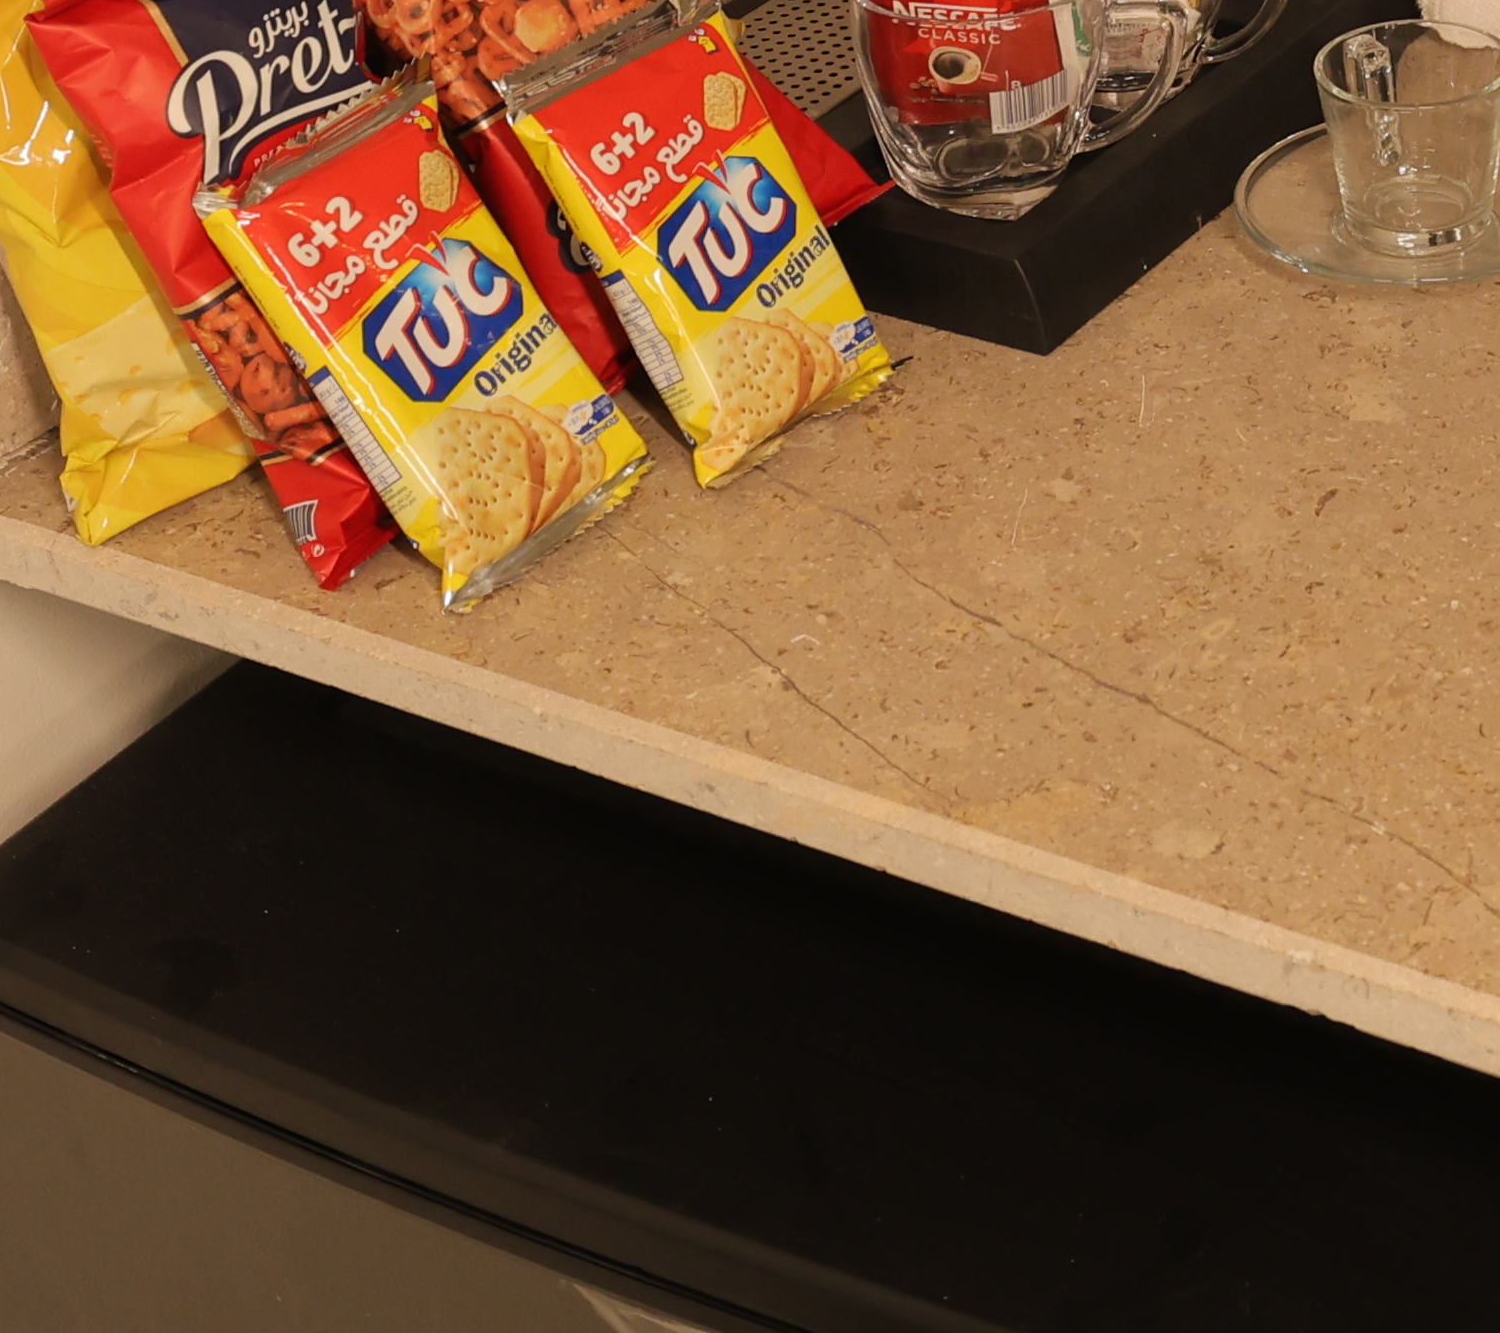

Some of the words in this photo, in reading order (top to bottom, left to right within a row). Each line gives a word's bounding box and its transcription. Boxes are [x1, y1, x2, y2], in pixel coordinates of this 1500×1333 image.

[917, 27, 1001, 45] CLASSIC
[589, 111, 656, 176] 6+2
[656, 114, 704, 183] قطع
[287, 196, 363, 267] 6+2
[362, 194, 419, 271] قطع
[668, 162, 789, 305] TUC
[755, 224, 831, 308] Original
[375, 245, 513, 396] TUC
[473, 311, 558, 397] Origina
